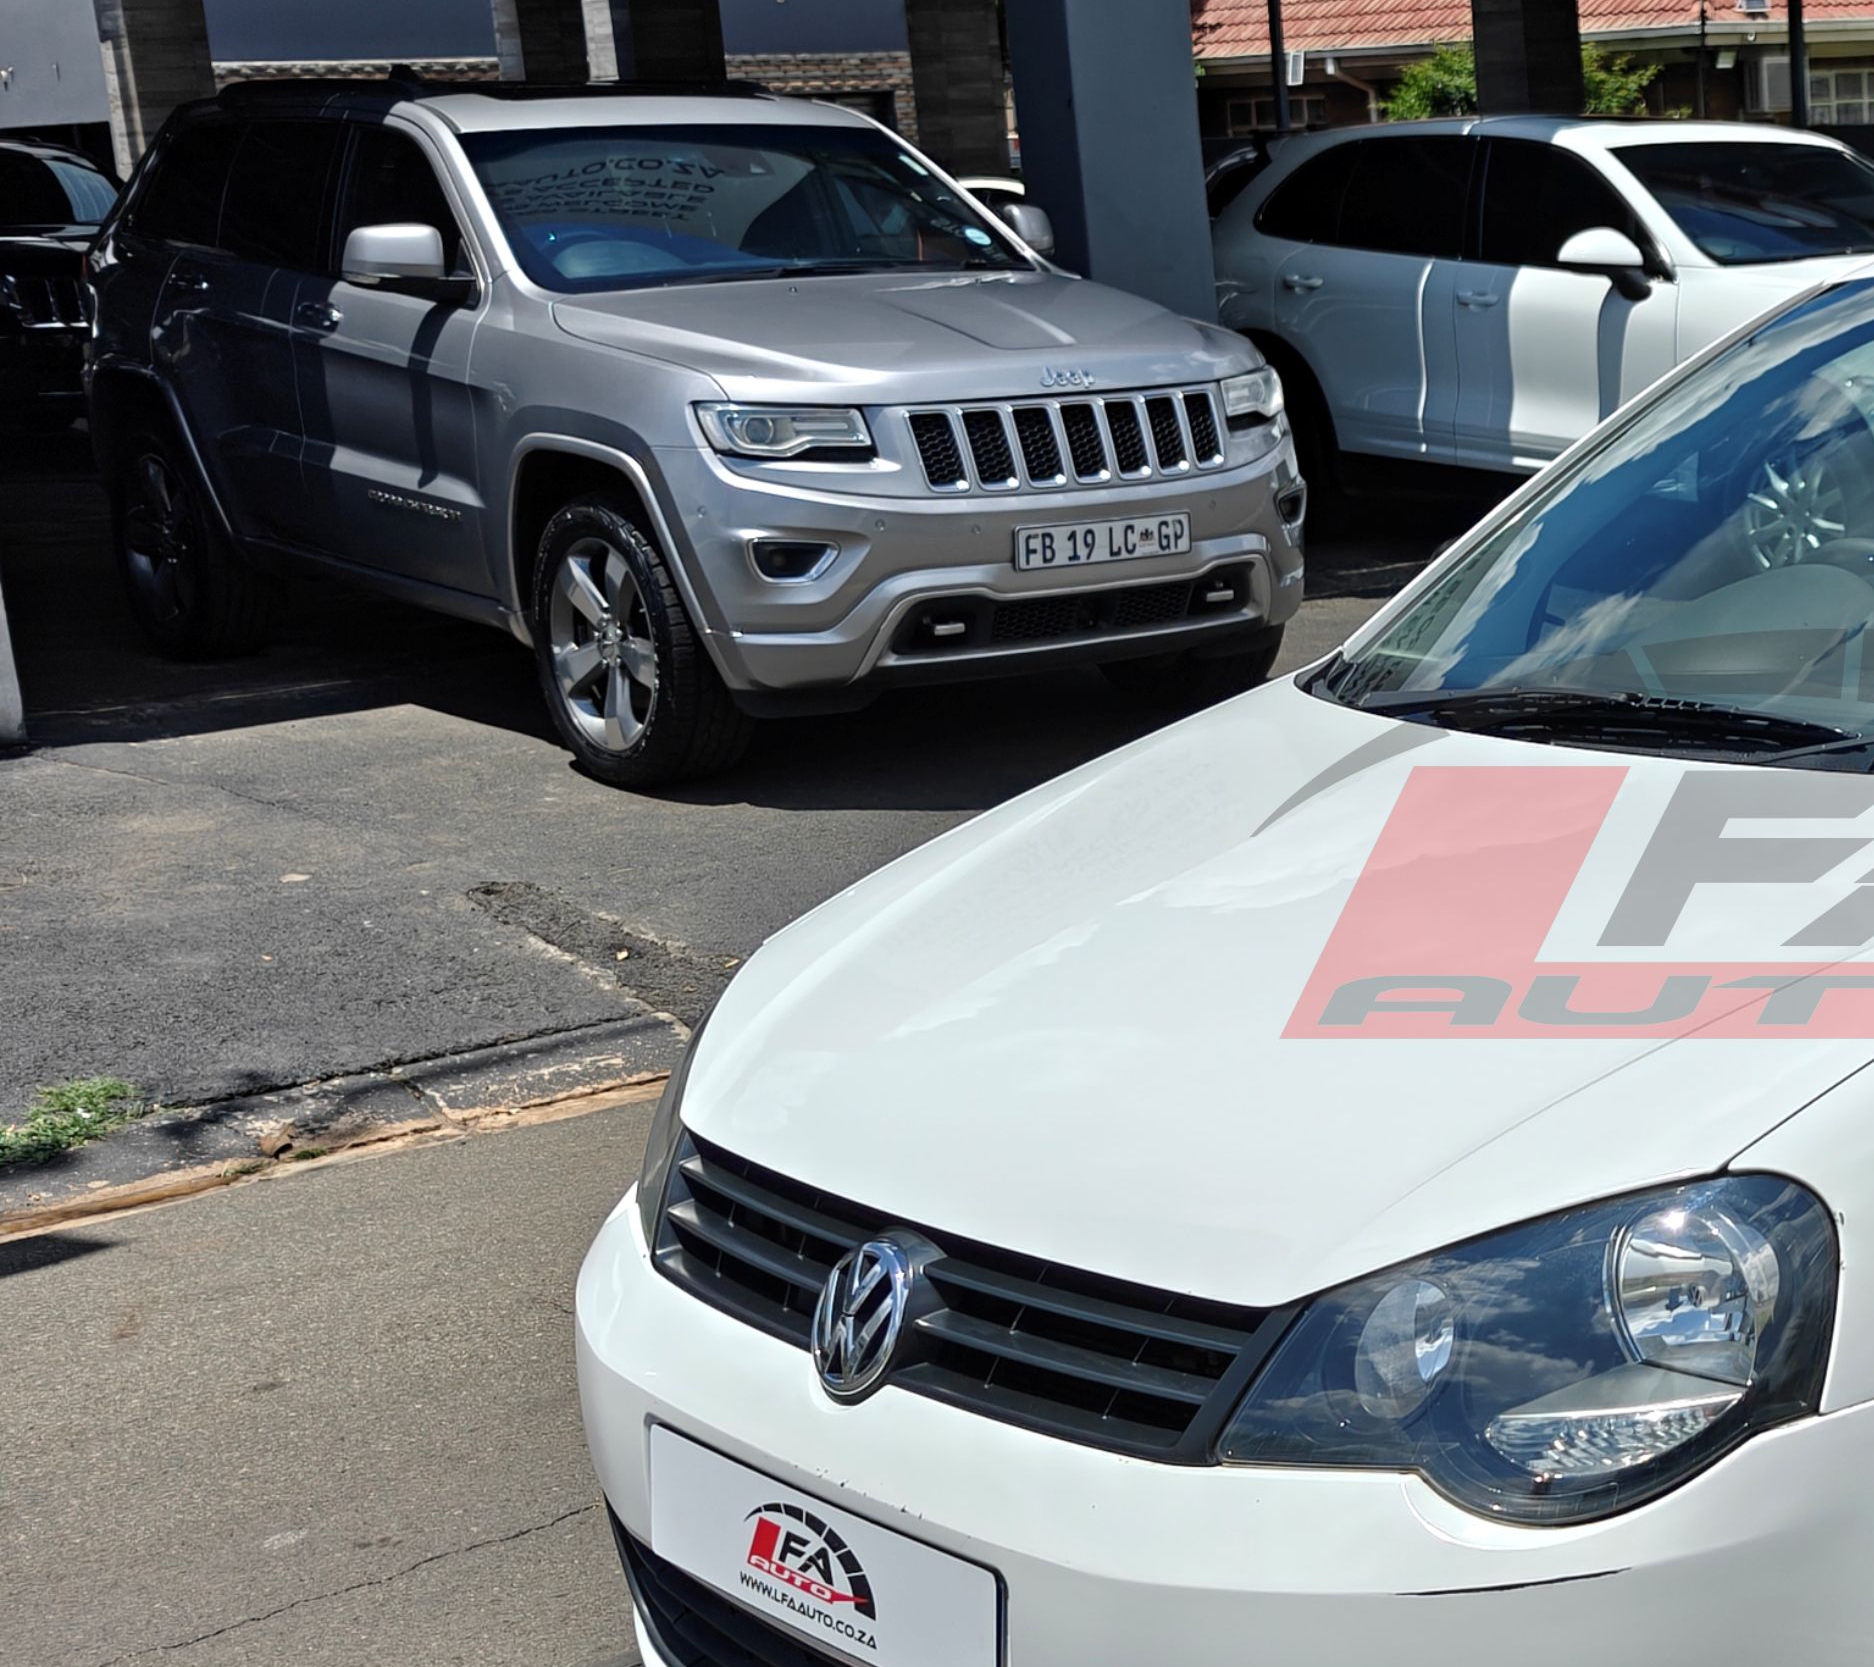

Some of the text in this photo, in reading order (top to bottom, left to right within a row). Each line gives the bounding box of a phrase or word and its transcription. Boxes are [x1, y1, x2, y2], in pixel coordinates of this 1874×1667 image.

[1040, 366, 1096, 389] Jeep
[1025, 518, 1184, 566] FB 19 LC GP
[750, 1555, 833, 1601] AUTO
[739, 1570, 877, 1650] WWW.LFAAUTO.CO.ZA
